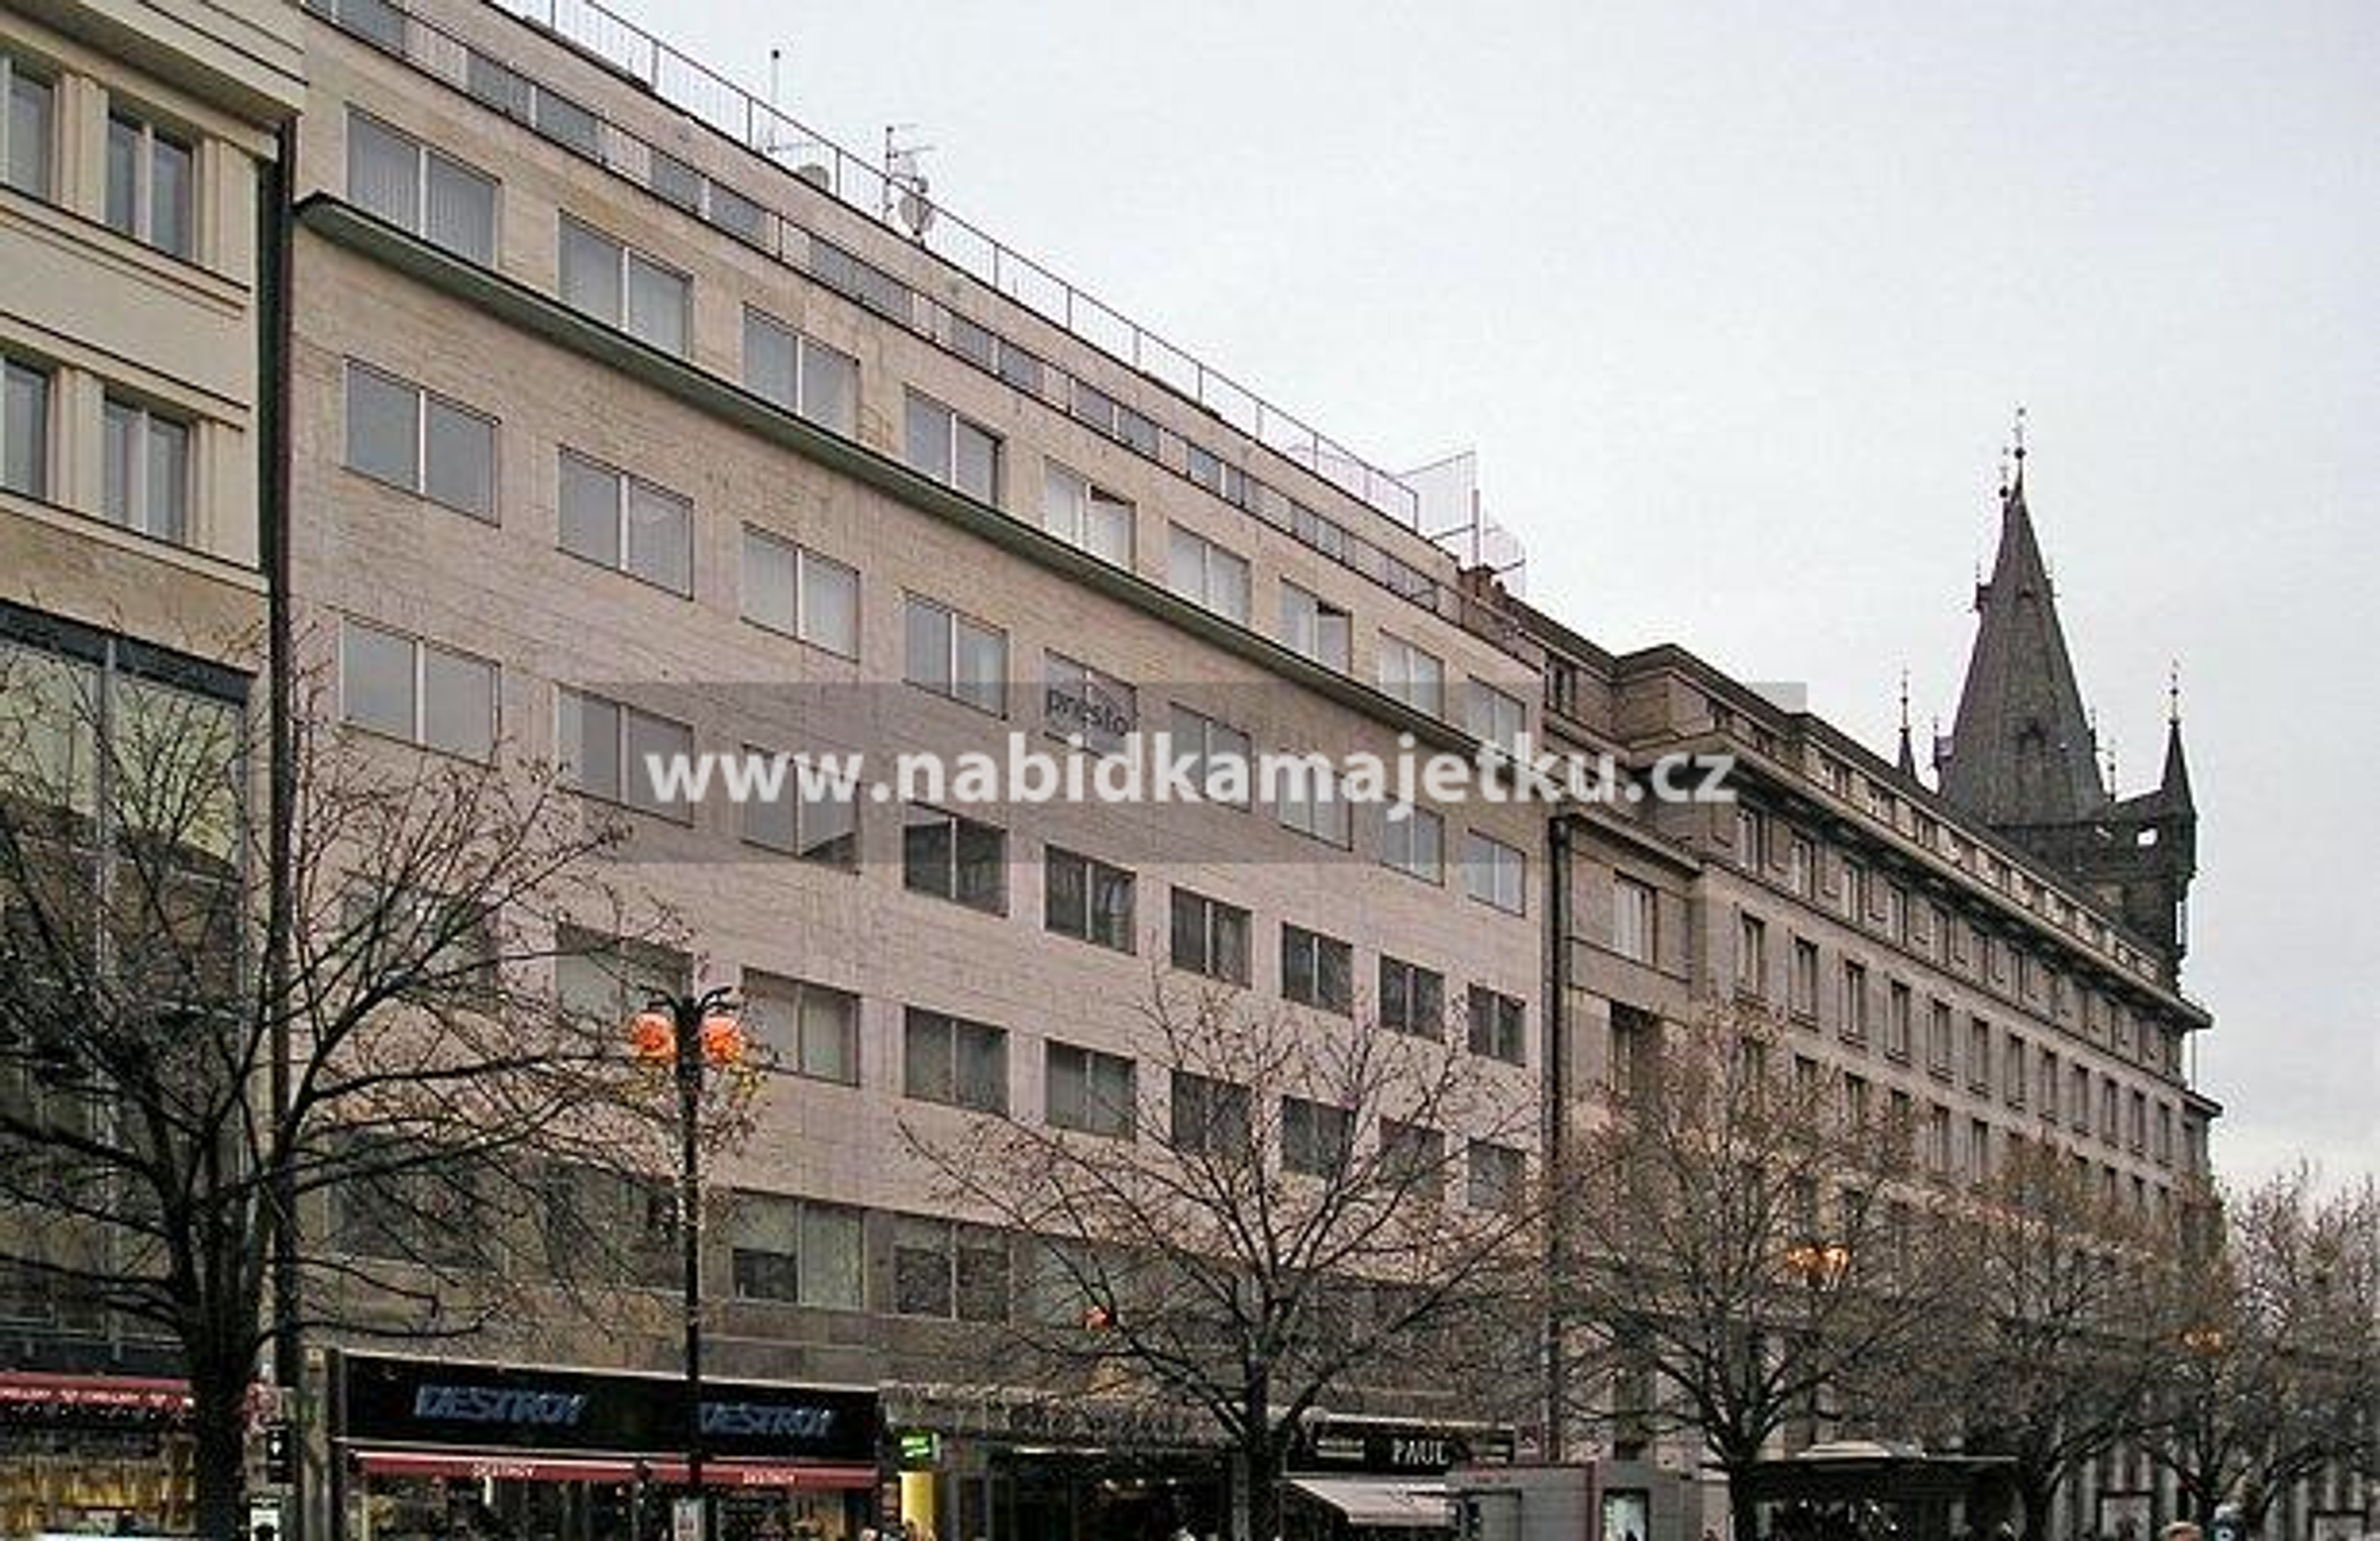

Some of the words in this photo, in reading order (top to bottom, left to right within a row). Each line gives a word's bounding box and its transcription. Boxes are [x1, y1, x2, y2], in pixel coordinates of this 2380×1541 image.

[414, 1385, 585, 1425] DESTROY
[700, 1401, 833, 1437] DESTROY
[1392, 1438, 1449, 1466] PAUL
